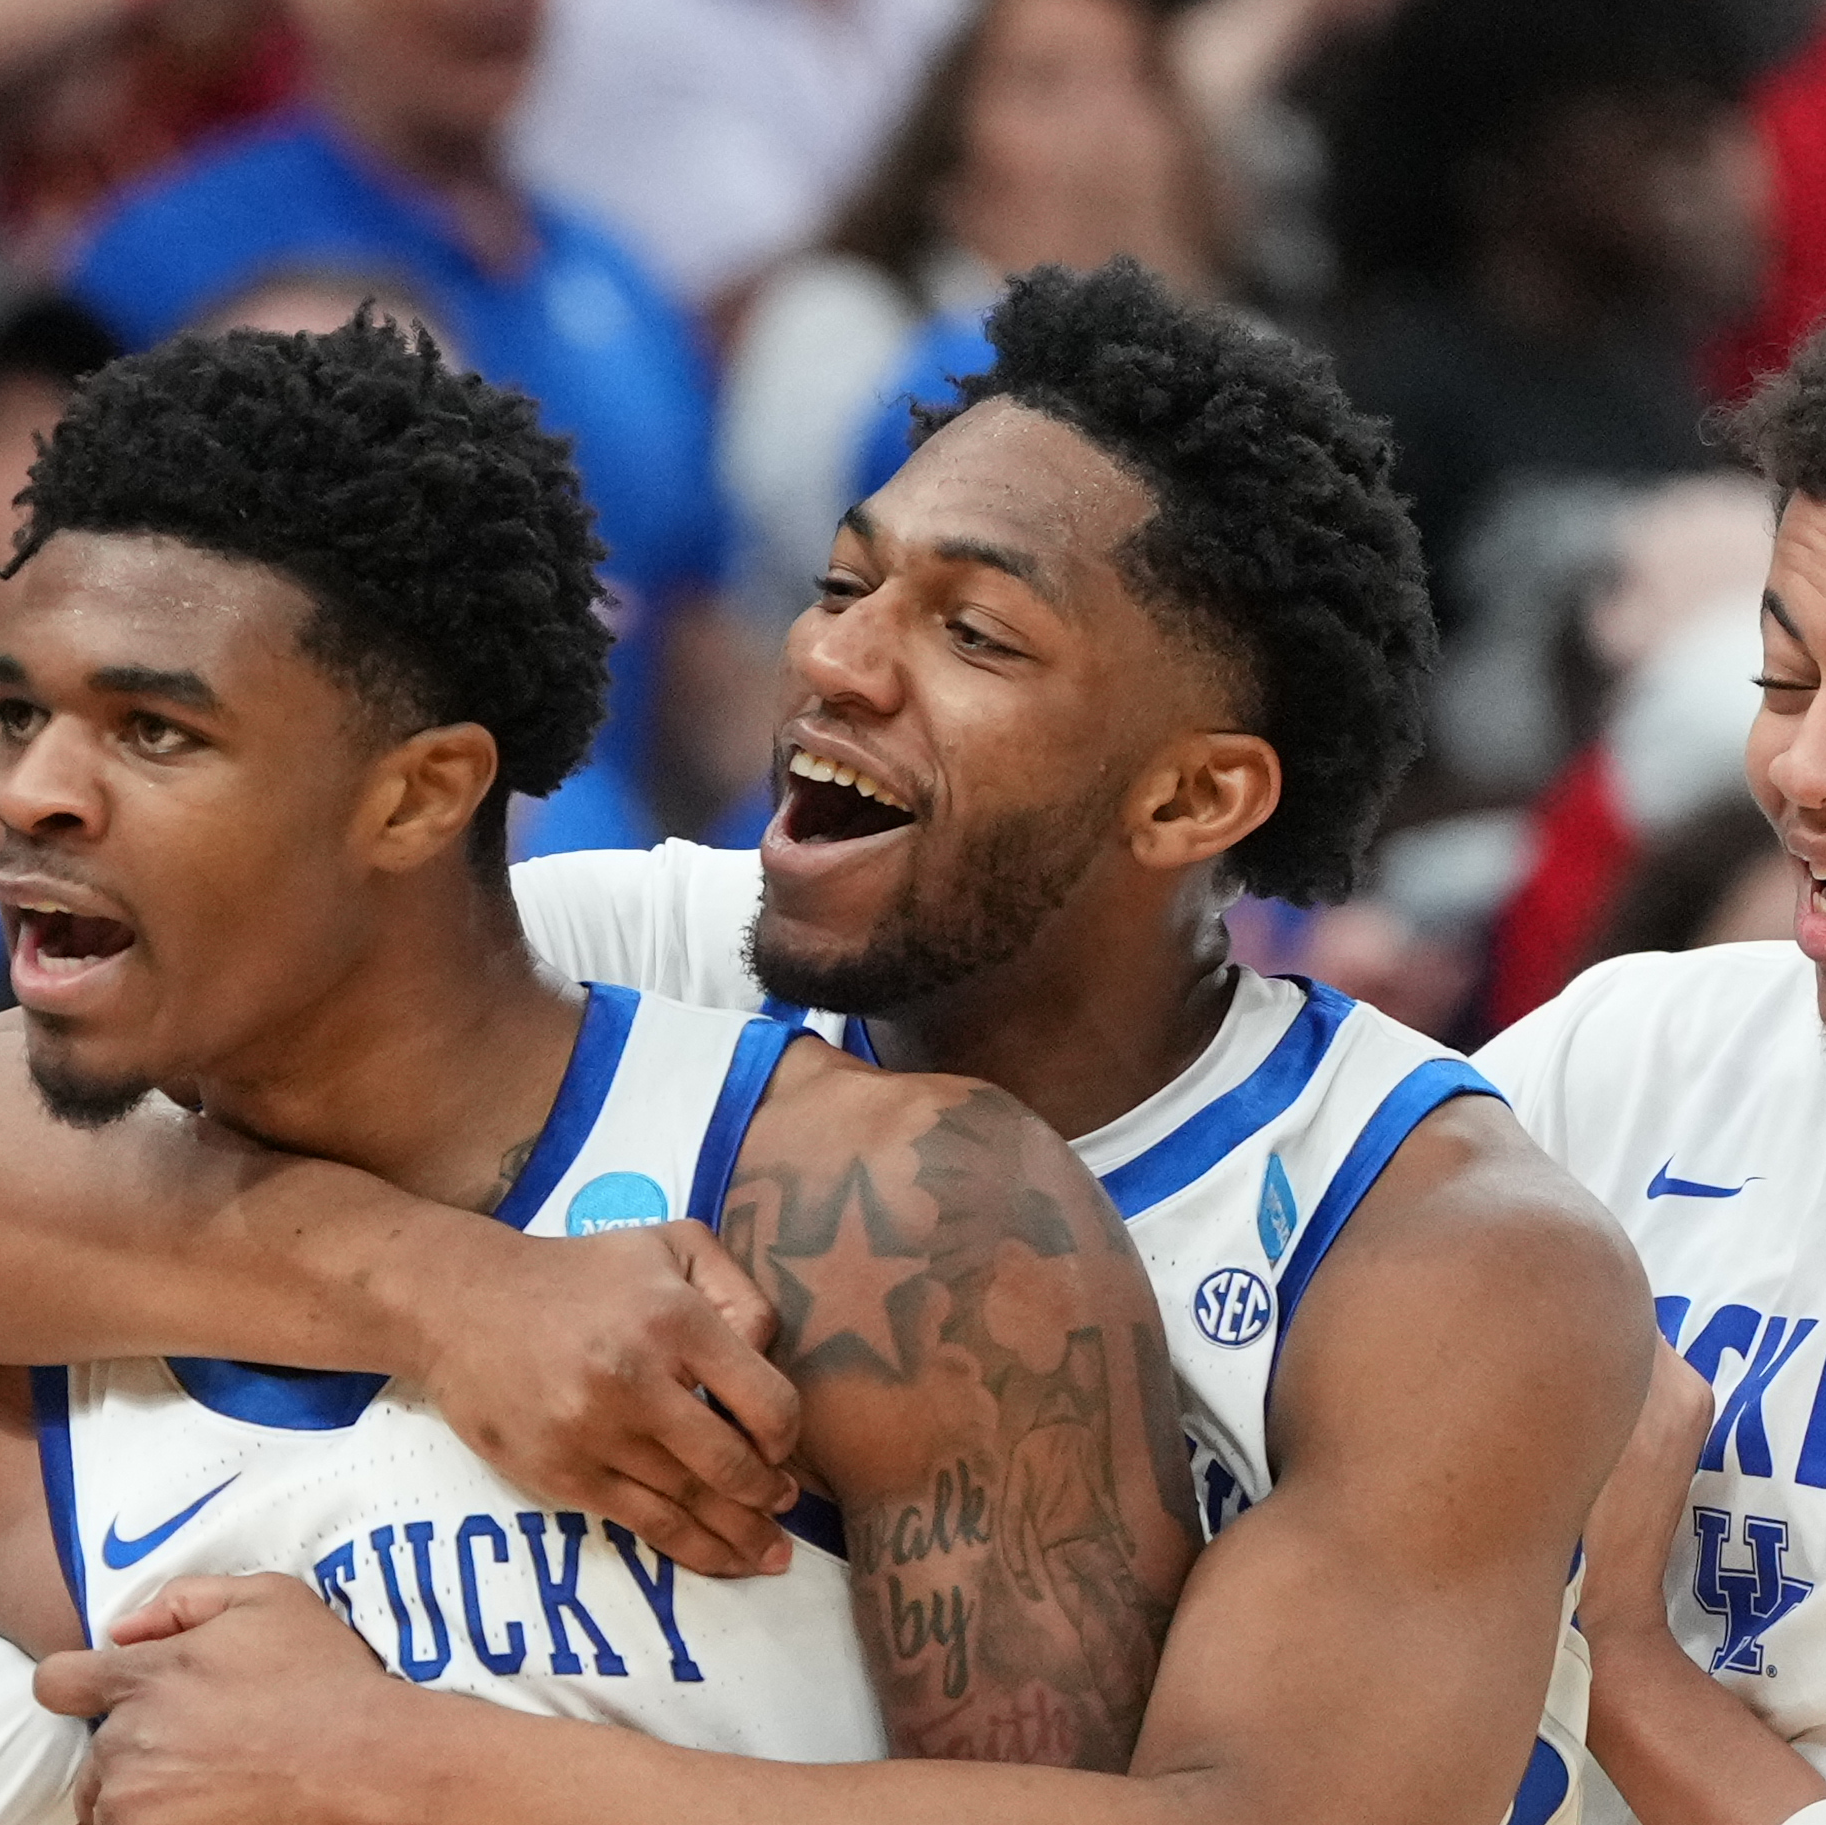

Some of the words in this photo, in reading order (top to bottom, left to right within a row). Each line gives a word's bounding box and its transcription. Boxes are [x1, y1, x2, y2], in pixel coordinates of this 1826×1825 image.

[1197, 1271, 1268, 1342] SEC
[313, 1511, 705, 1684] TUCKY
[888, 1574, 973, 1699] by
[1692, 1505, 1815, 1676] UK
